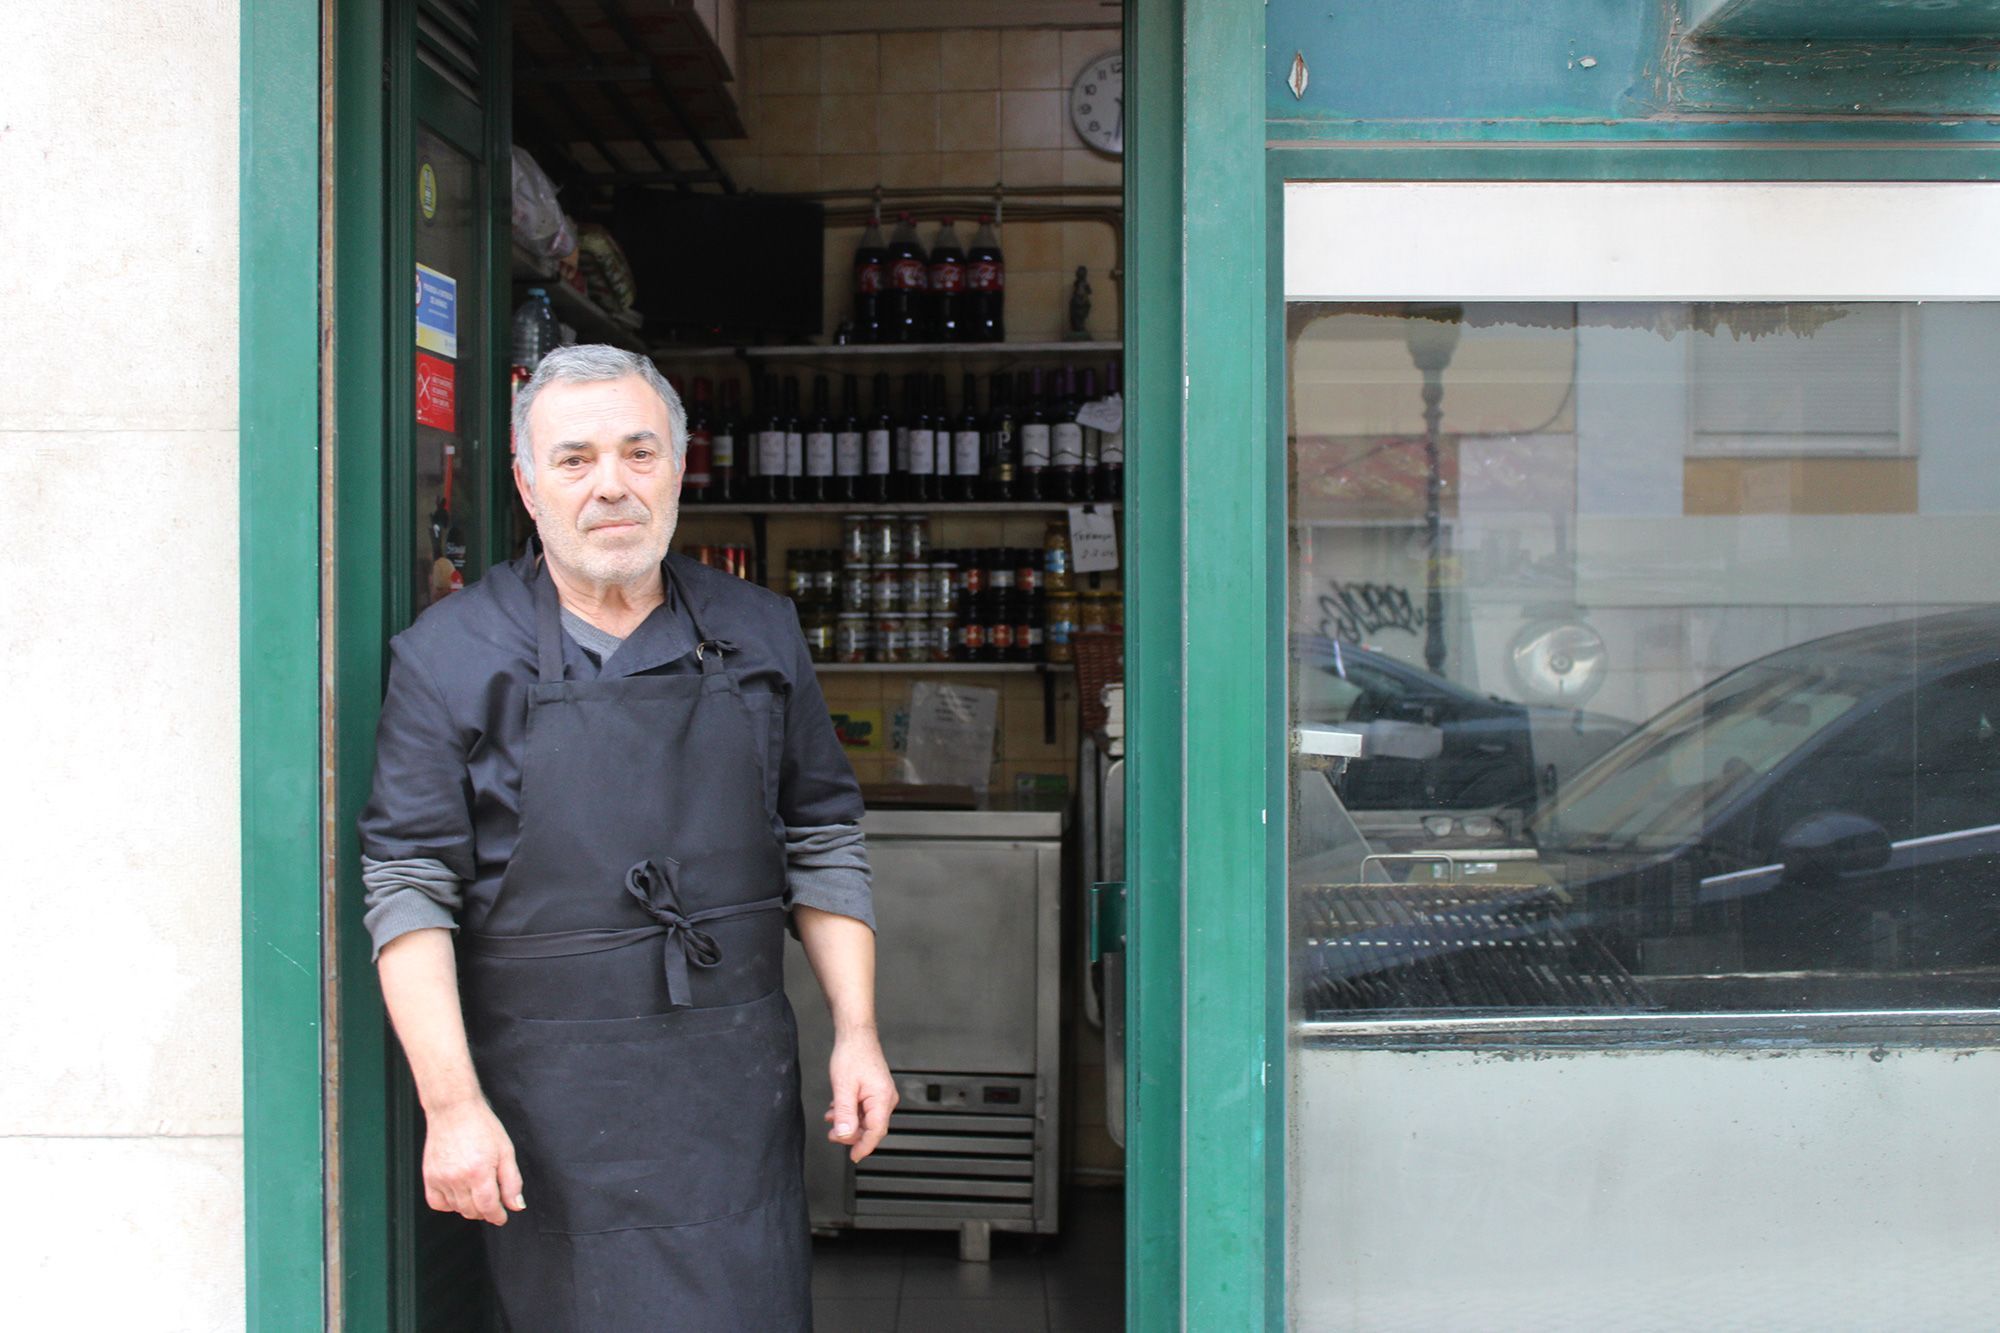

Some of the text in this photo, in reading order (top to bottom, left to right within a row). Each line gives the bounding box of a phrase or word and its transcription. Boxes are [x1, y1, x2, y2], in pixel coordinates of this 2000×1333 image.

[1084, 83, 1097, 96] 10
[1080, 103, 1092, 115] 9
[1089, 120, 1100, 132] 8
[1103, 131, 1112, 144] 7
